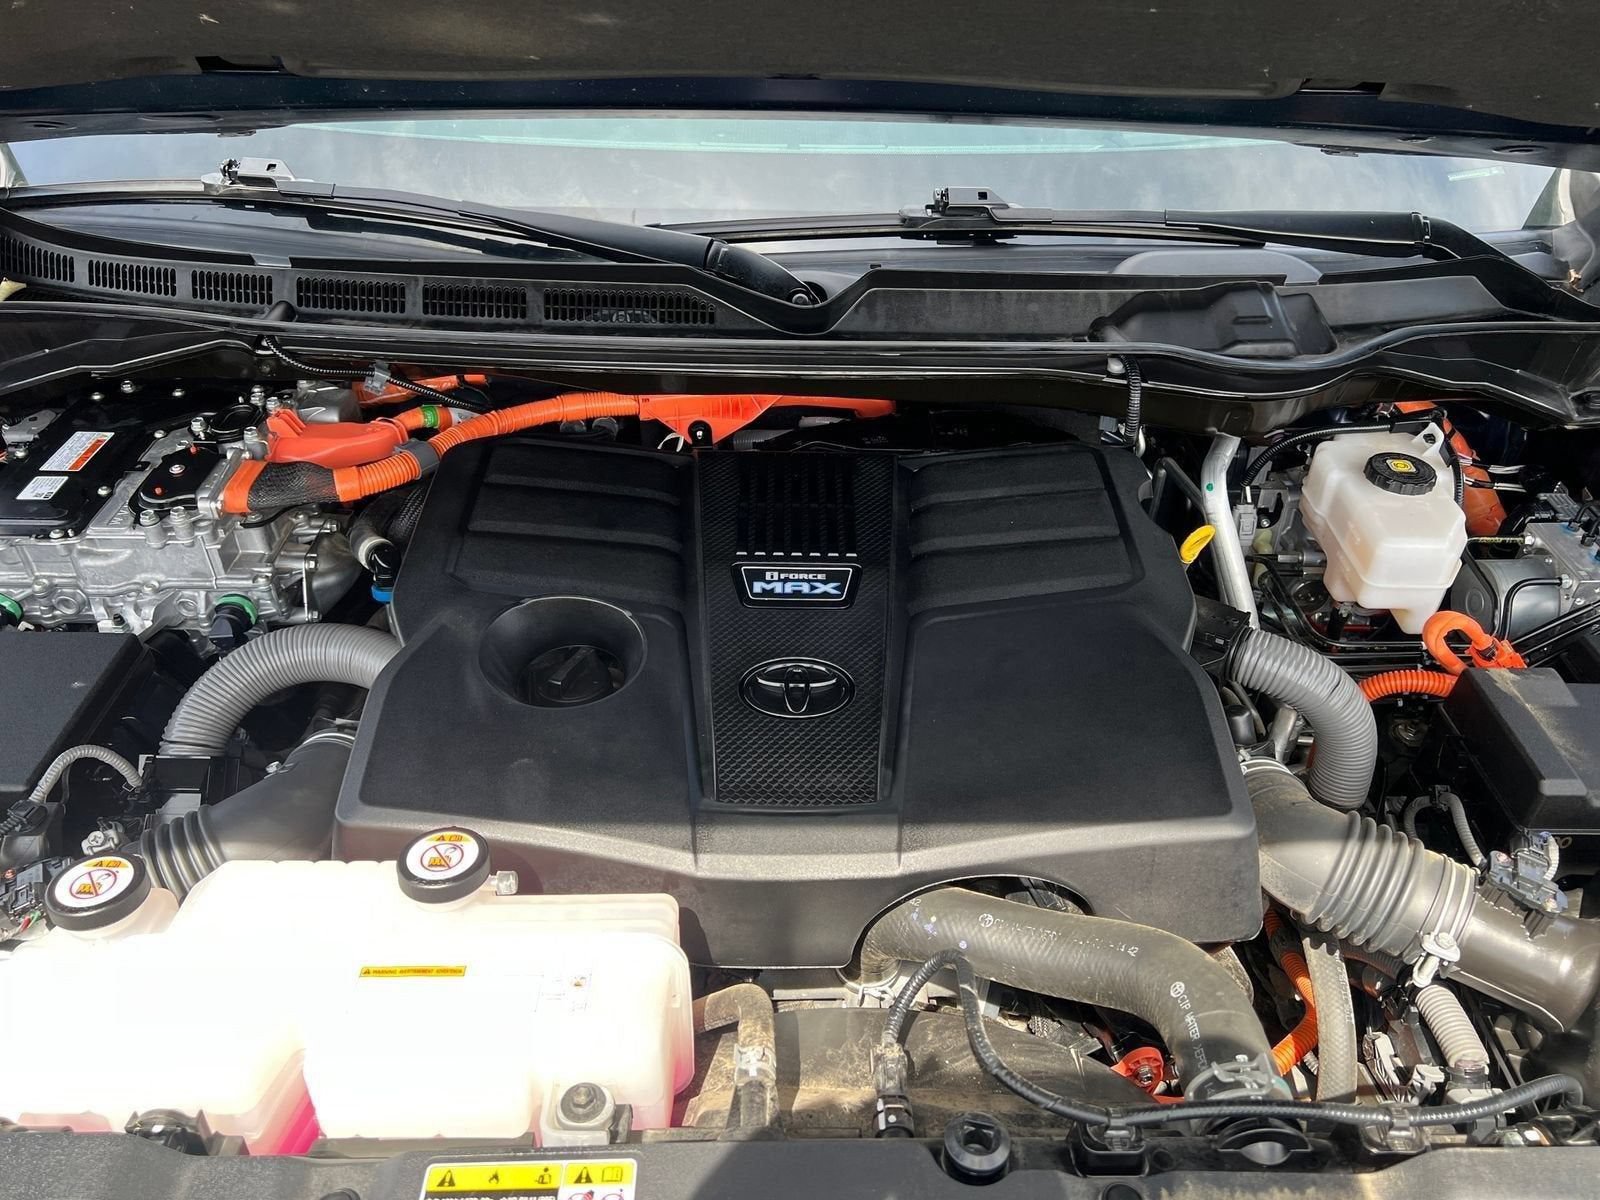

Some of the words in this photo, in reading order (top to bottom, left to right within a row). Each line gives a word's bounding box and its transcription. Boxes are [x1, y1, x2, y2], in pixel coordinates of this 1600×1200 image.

[752, 581, 842, 595] MAX
[1177, 993, 1191, 1010] CIP
[1184, 1011, 1201, 1042] WATER
